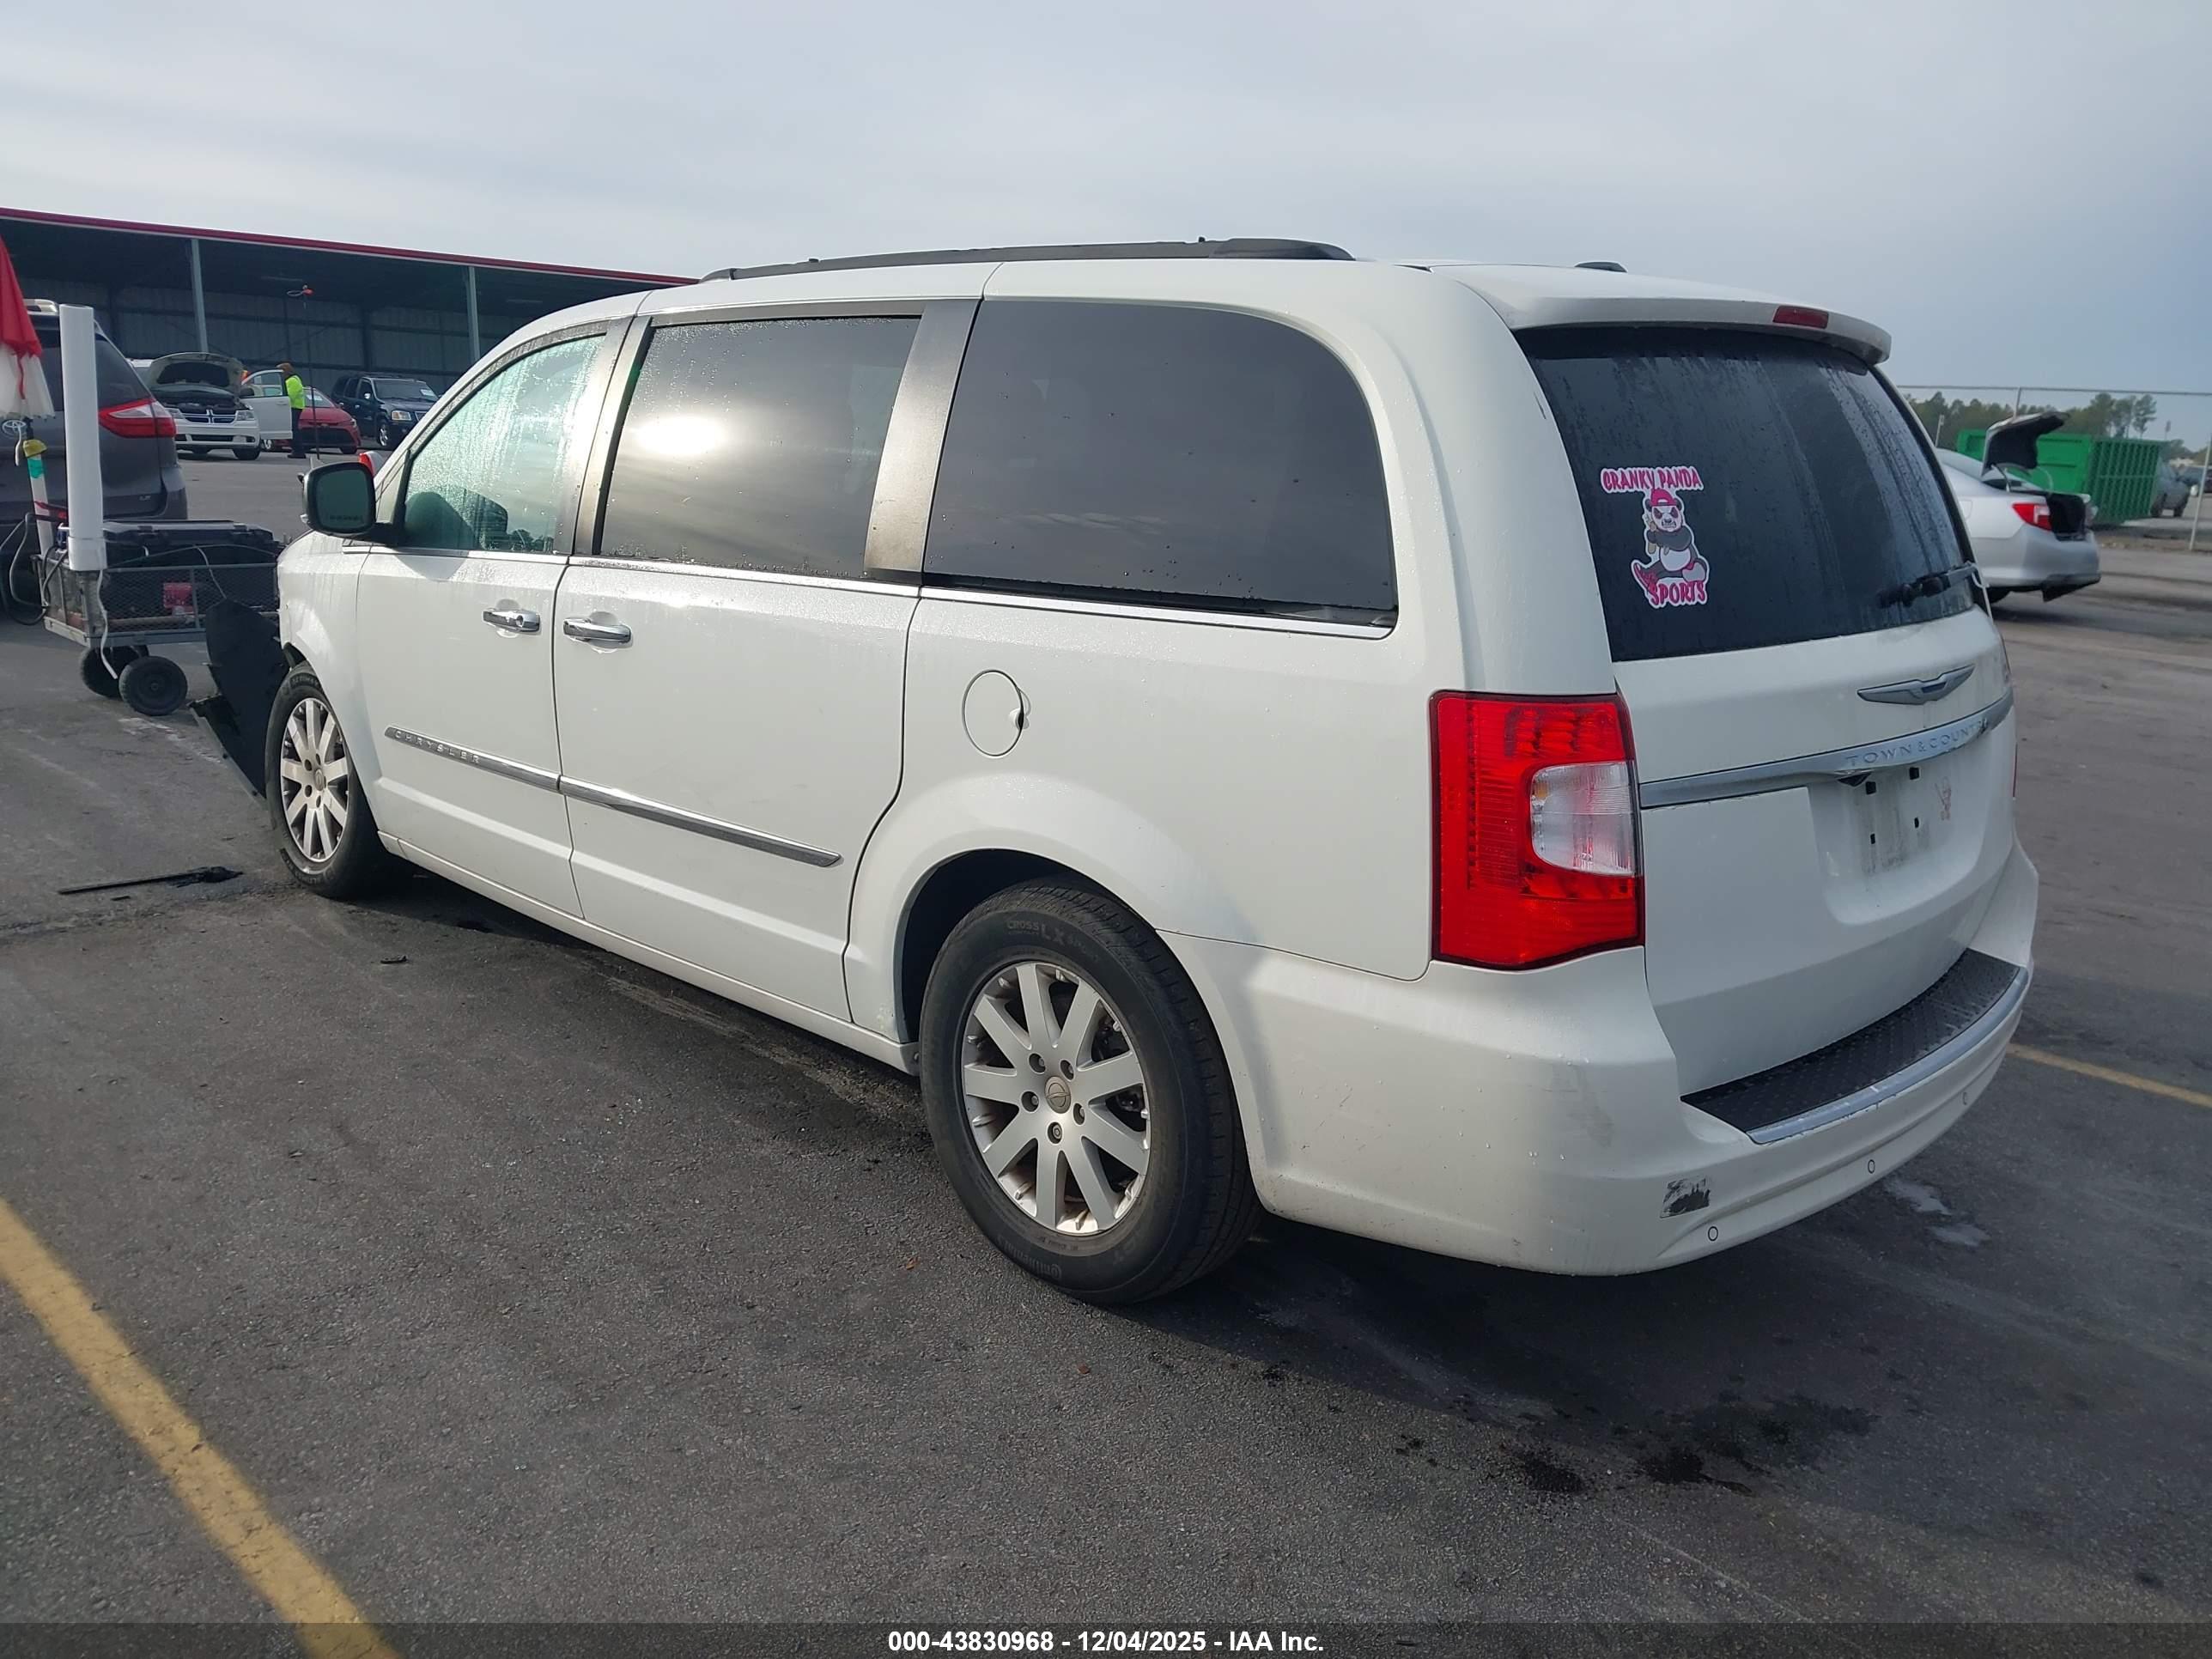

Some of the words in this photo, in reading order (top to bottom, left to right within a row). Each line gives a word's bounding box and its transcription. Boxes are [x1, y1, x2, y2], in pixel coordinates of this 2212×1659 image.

[1602, 470, 1655, 490] CRANKY
[1657, 468, 1701, 489] PANDA
[1649, 581, 1705, 605] SPORTS
[393, 730, 481, 764] CHRYSLER
[1845, 744, 1912, 767] TOWN
